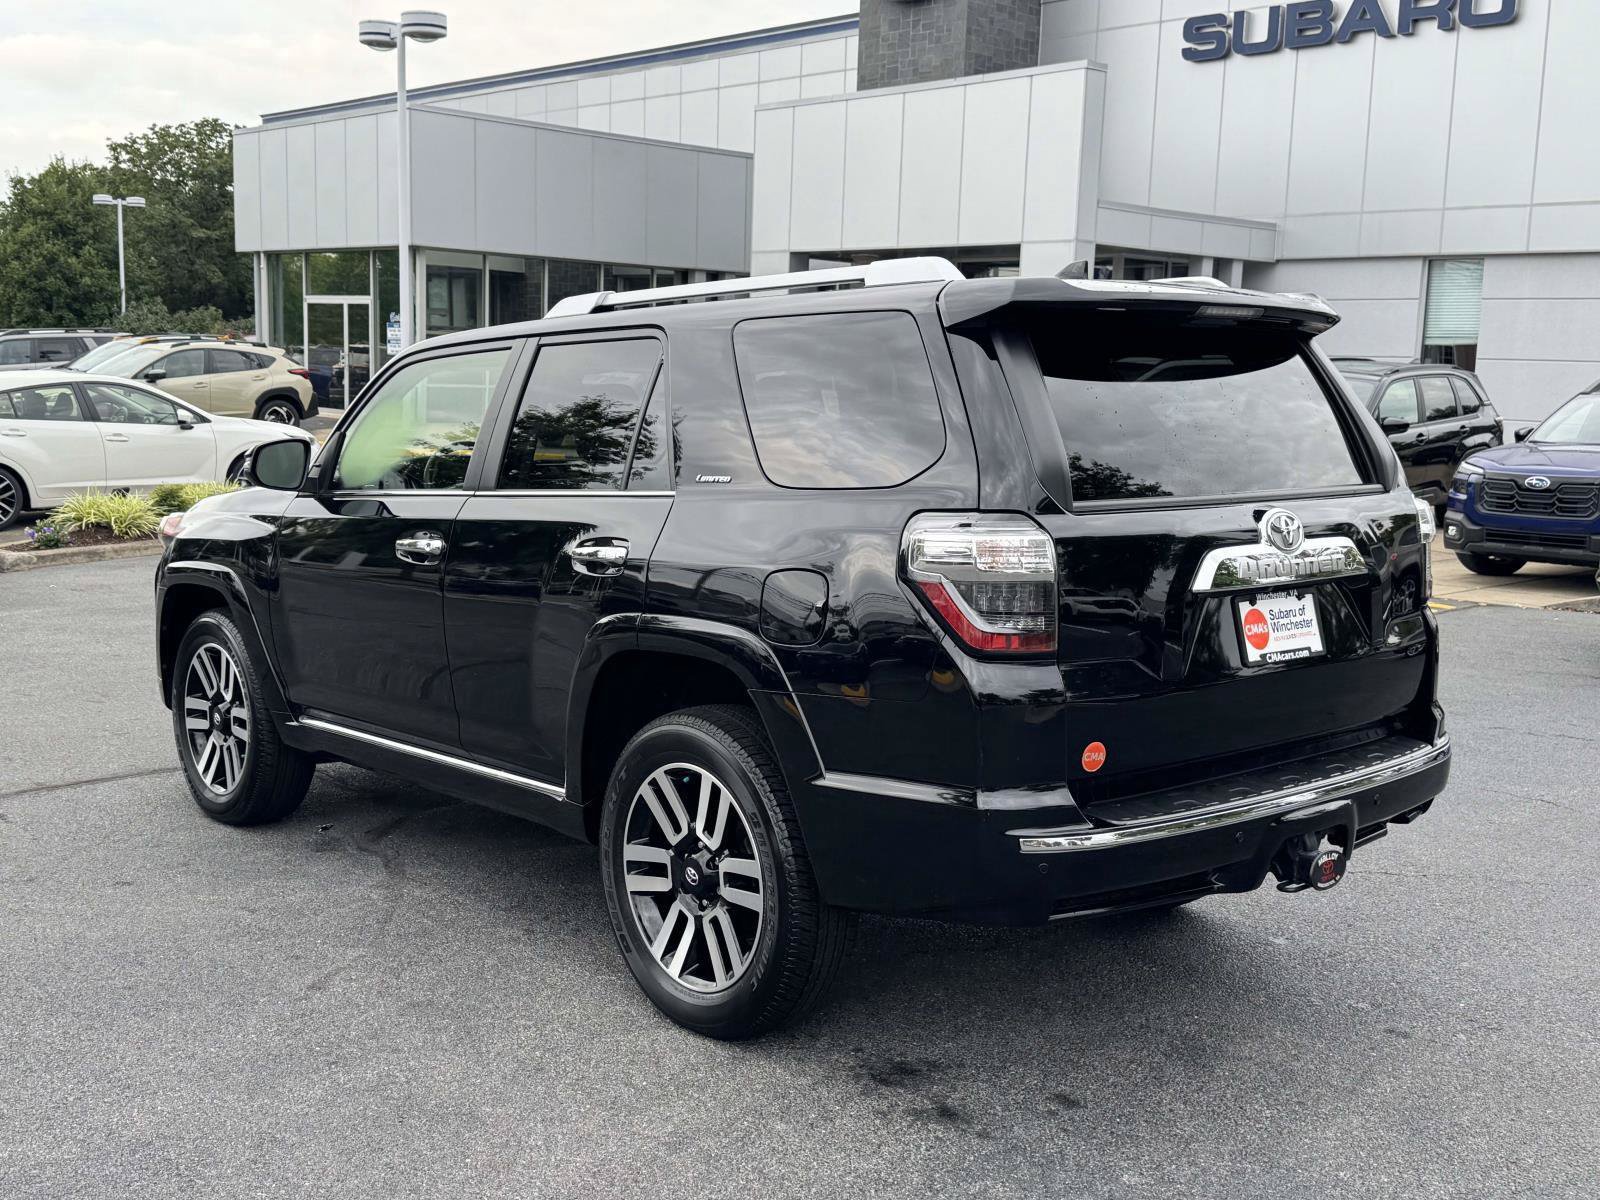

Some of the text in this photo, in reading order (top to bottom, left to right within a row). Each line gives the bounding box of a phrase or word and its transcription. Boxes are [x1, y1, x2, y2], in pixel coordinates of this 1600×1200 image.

[1181, 0, 1521, 62] SUBARU
[1256, 589, 1299, 601] Winchester, VA
[1269, 604, 1306, 621] Subaru of
[1245, 622, 1268, 636] CMA's
[1270, 618, 1313, 634] Winchester
[1266, 649, 1310, 663] CMAcars.com
